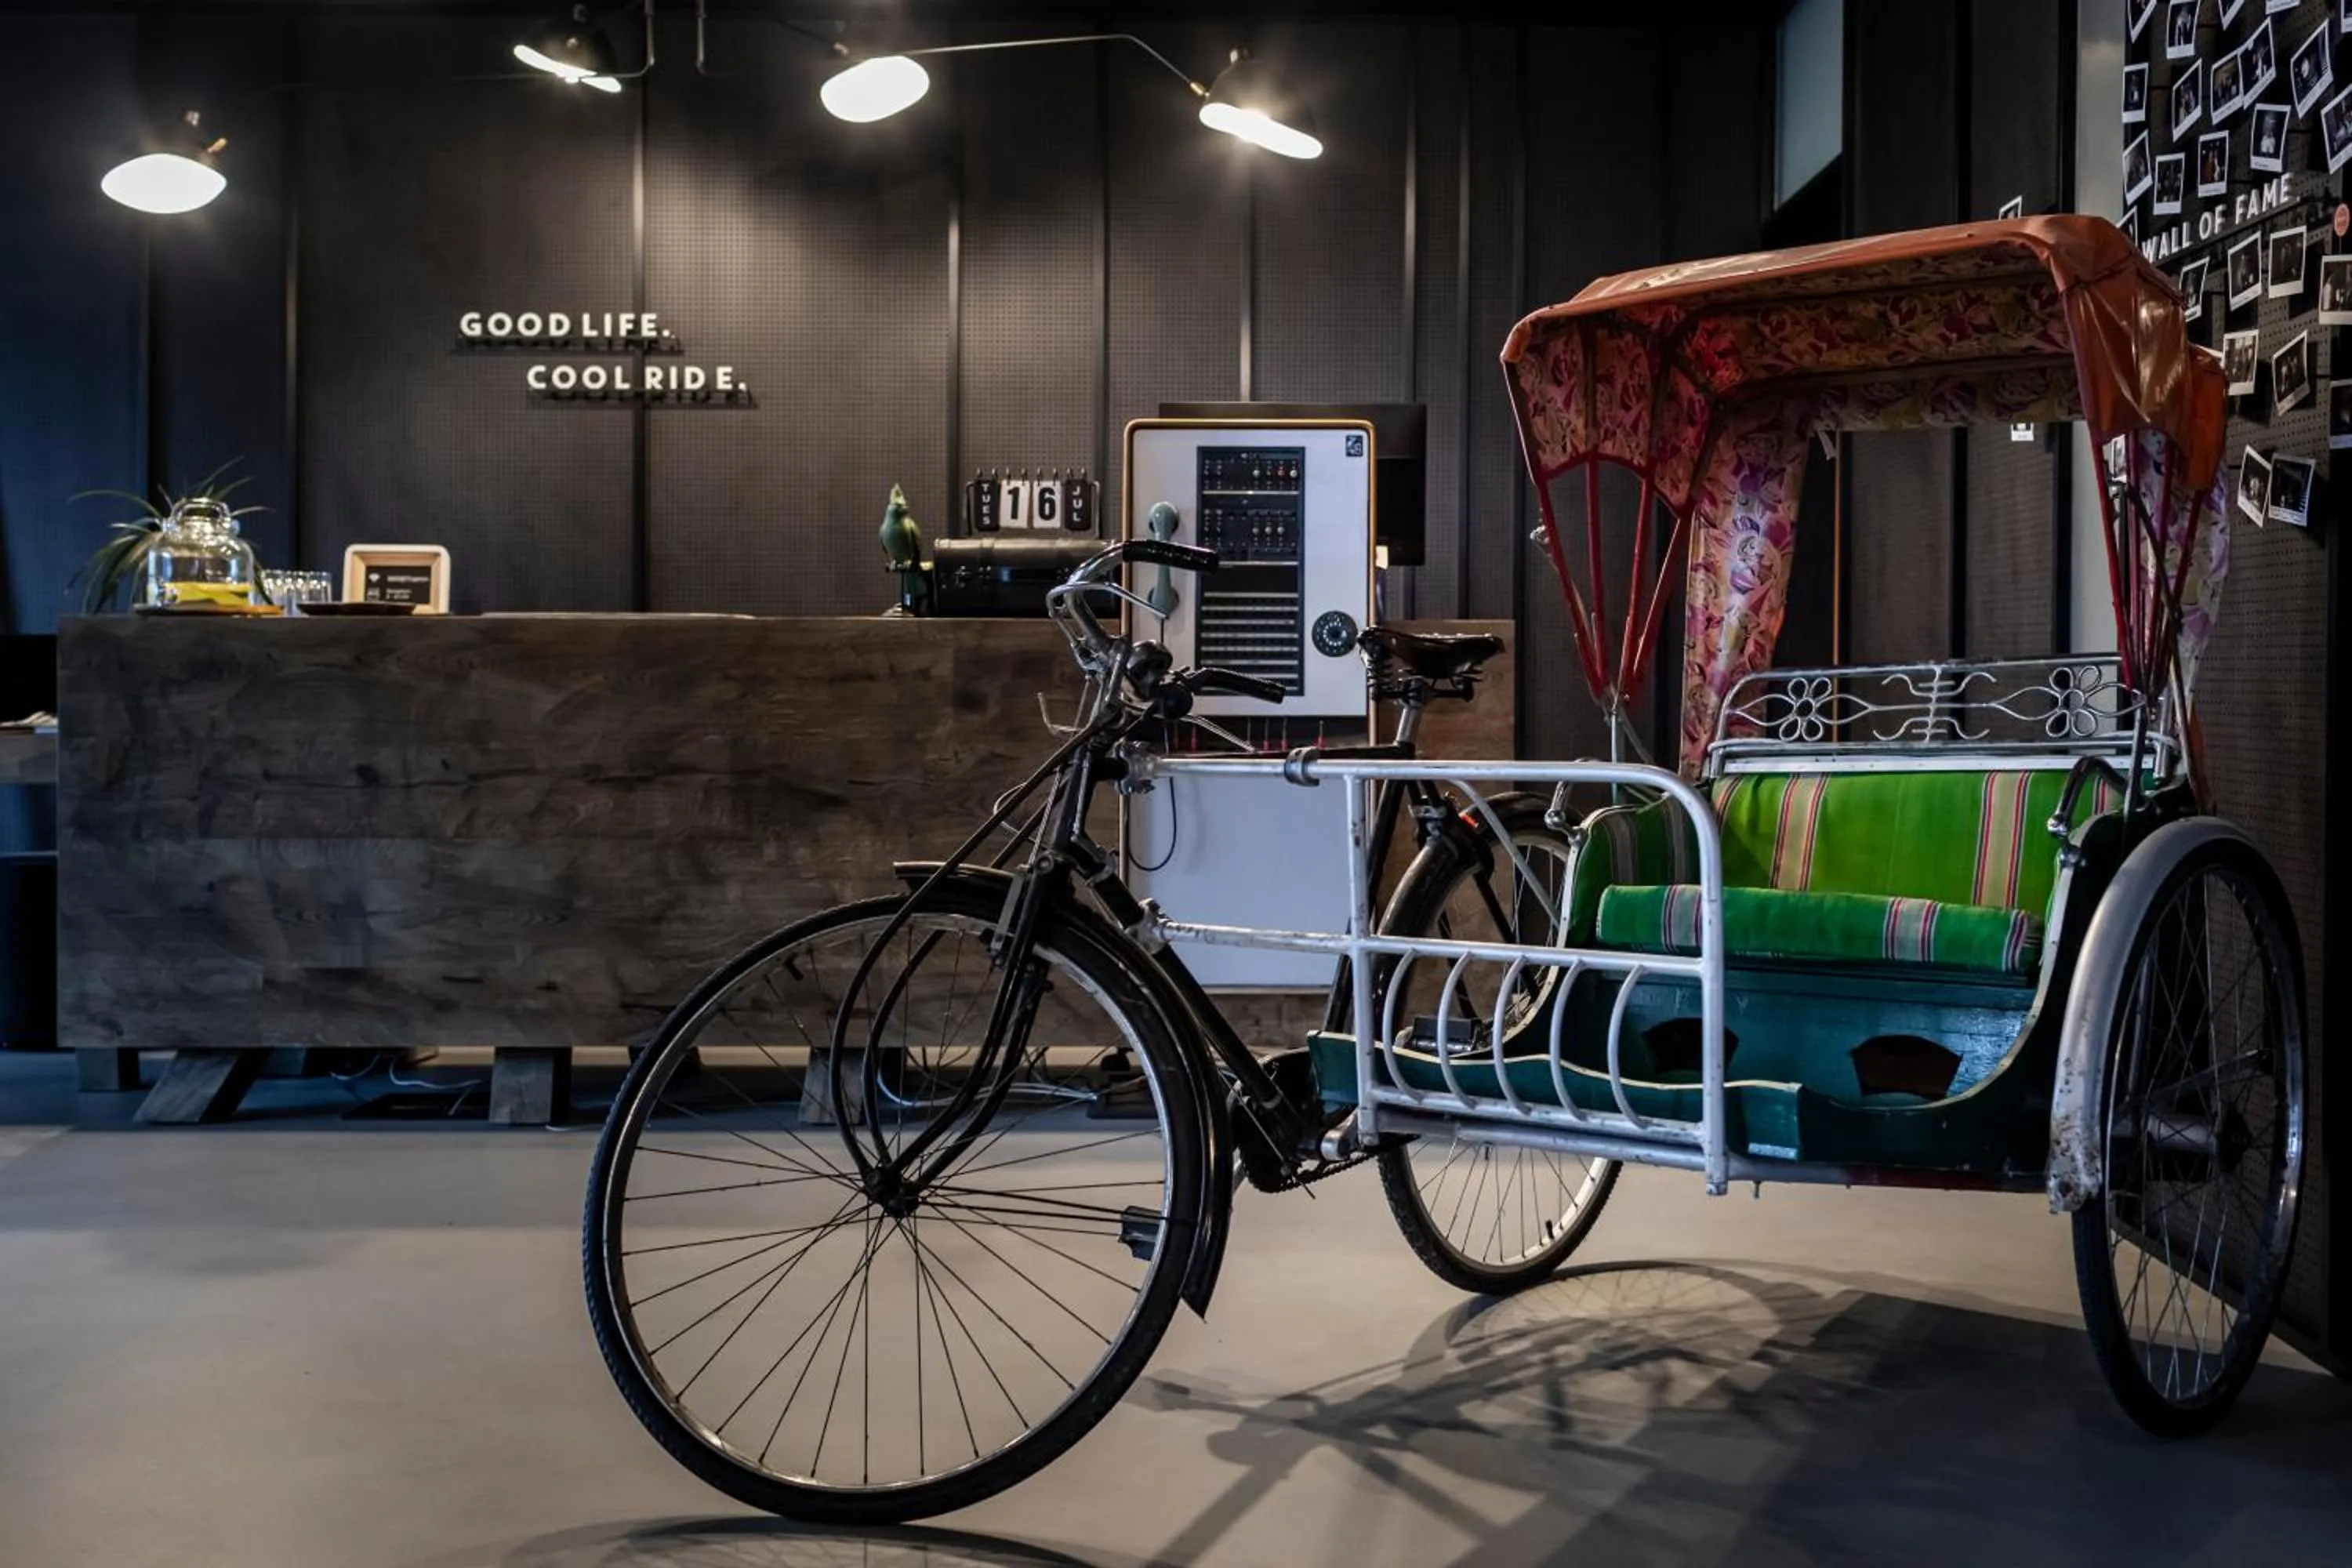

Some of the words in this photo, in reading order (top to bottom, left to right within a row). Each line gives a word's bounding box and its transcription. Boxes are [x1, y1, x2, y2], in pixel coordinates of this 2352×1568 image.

[2141, 222, 2194, 263] WALL
[2199, 203, 2227, 240] OF
[459, 312, 572, 337] GOOD
[582, 313, 670, 338] LIFE.
[527, 365, 631, 390] COOL
[644, 365, 747, 391] RIDE.
[982, 483, 991, 525] TUES
[1072, 485, 1083, 522] JUL
